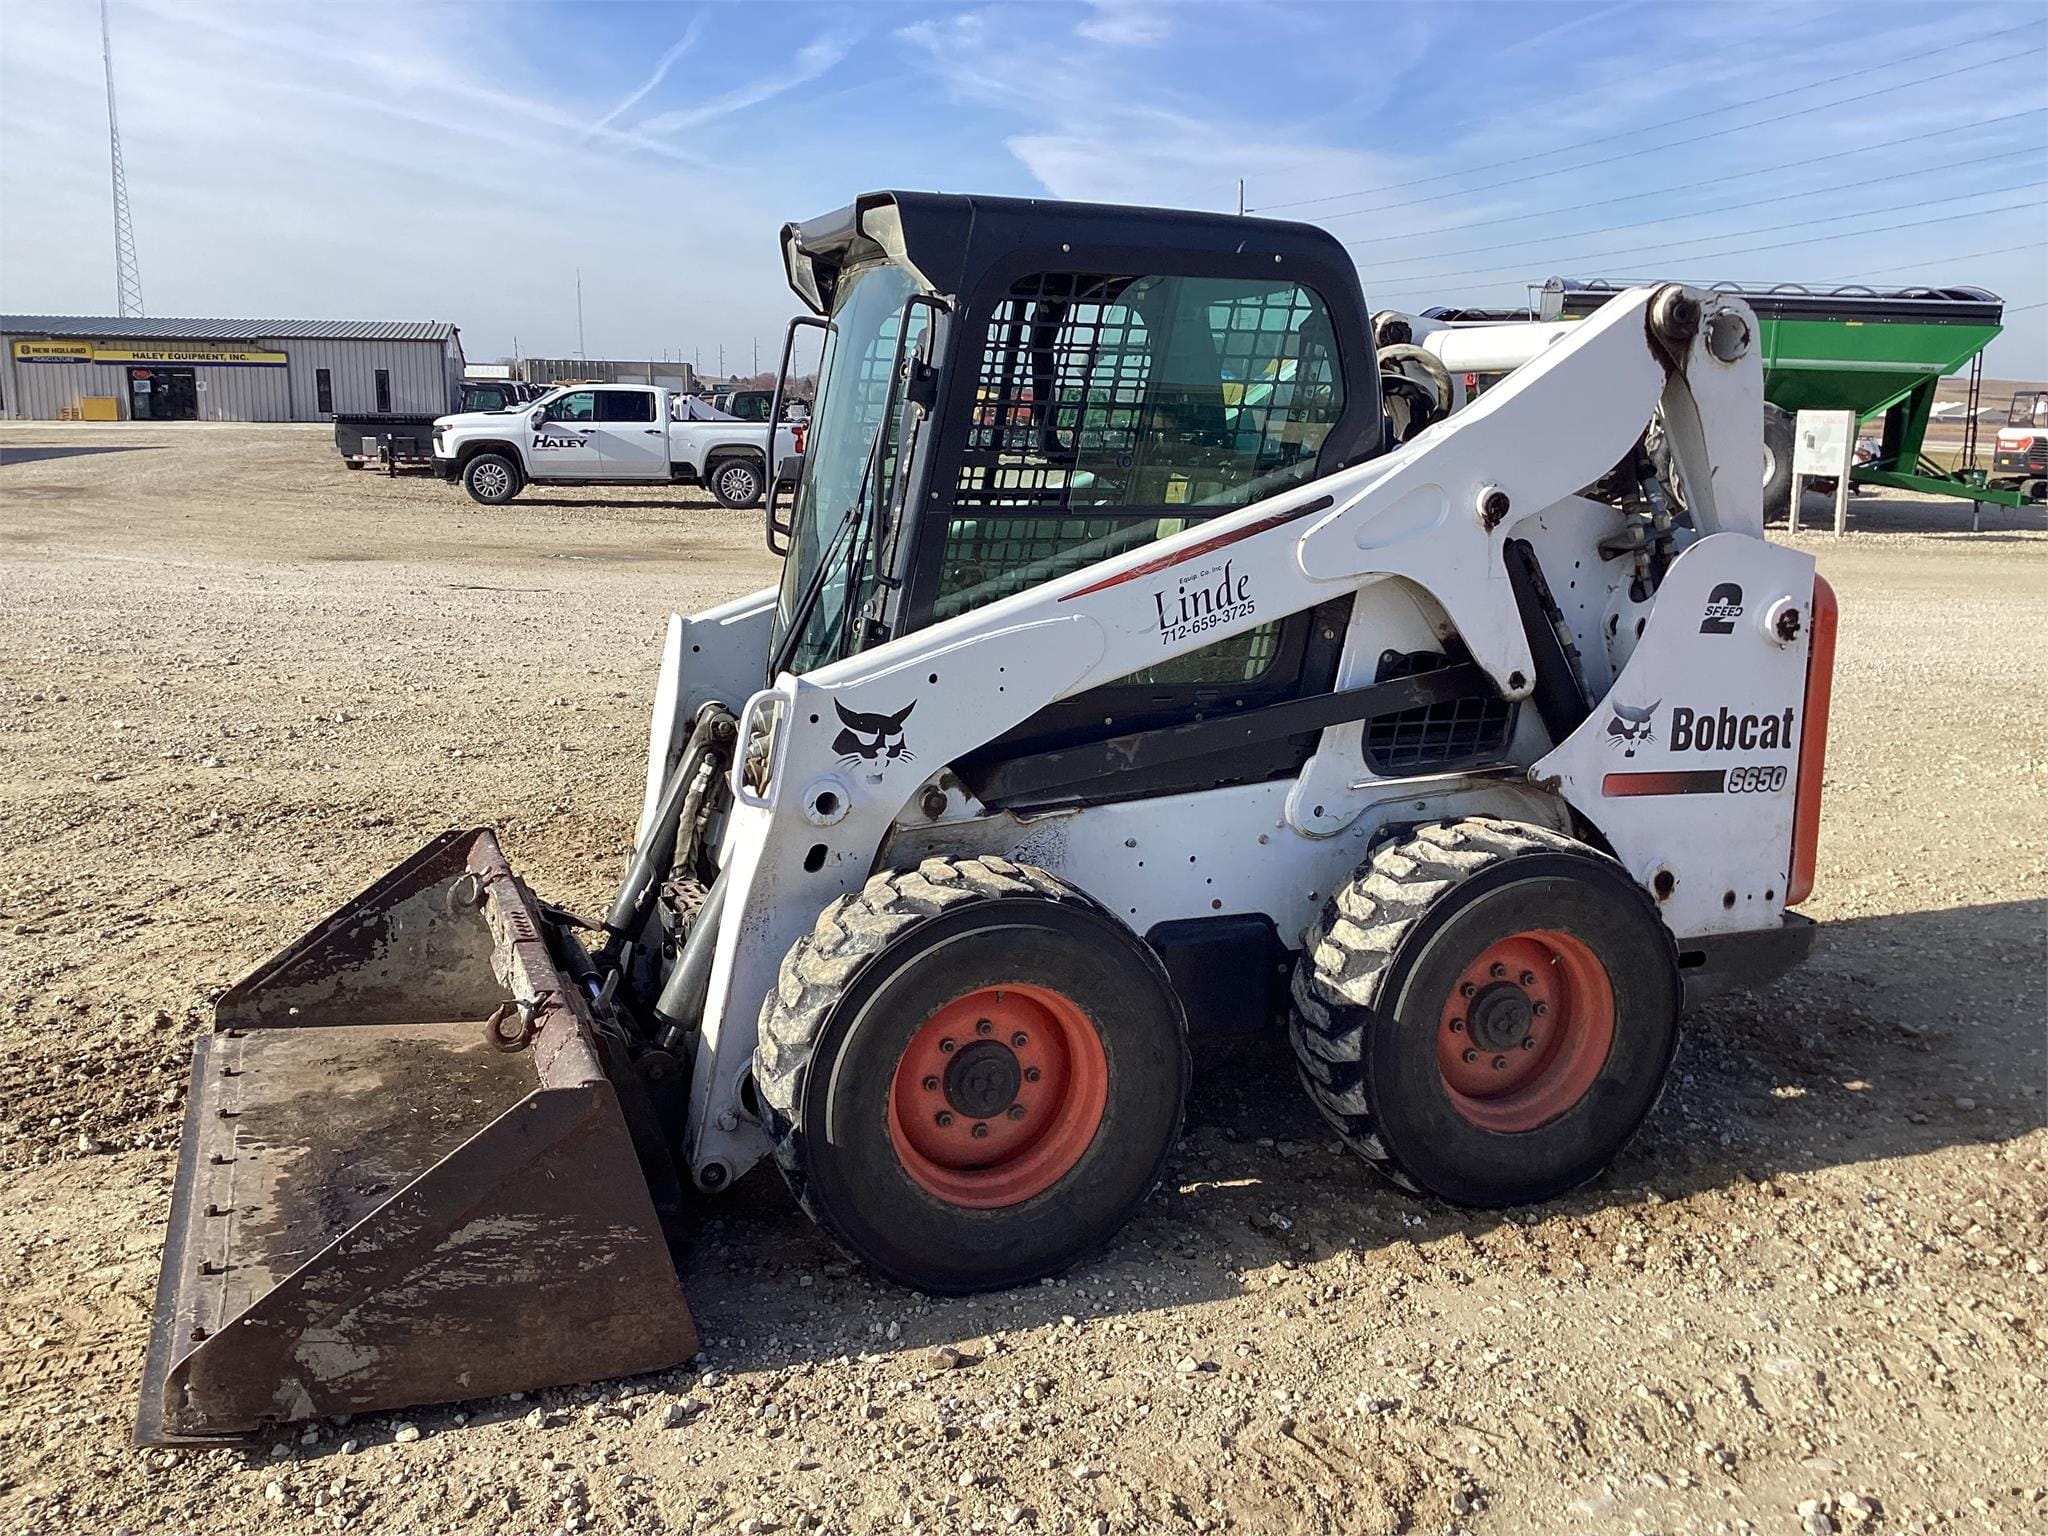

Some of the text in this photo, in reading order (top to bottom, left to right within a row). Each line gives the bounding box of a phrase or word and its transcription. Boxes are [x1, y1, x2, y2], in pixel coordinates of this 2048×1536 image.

[132, 352, 164, 360] HALEY
[168, 353, 226, 361] EQUIPMENT,
[1154, 559, 1250, 630] Linde
[1699, 582, 1743, 634] 2
[1704, 605, 1743, 617] SPEED
[1161, 600, 1255, 645] 712-659-3725
[1670, 707, 1794, 751] Bobcat
[1728, 766, 1787, 793] S650
